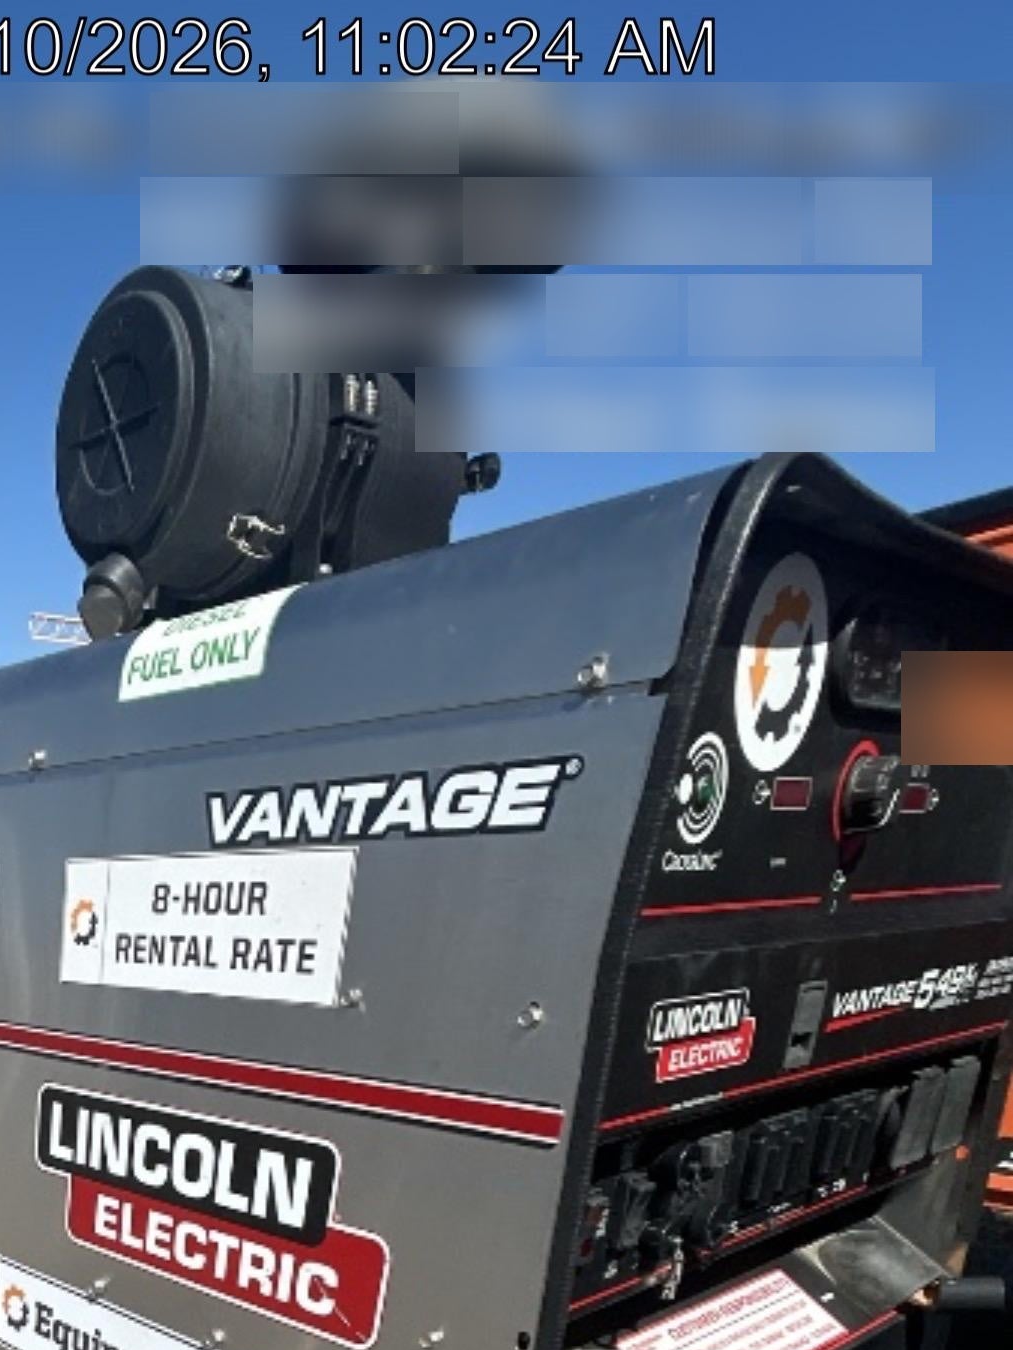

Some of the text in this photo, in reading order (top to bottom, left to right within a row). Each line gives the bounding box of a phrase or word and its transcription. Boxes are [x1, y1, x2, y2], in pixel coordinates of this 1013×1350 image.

[127, 626, 261, 684] FUEL ONLY
[151, 881, 268, 916] 8-HOUR
[114, 933, 319, 976] RENTAL RATE
[652, 998, 742, 1042] LINCOLN
[832, 979, 918, 1018] VANTAGE
[668, 1036, 745, 1072] ELECTRIC
[48, 1101, 312, 1228] LINCOLN
[93, 1194, 340, 1316] ELECTRIC
